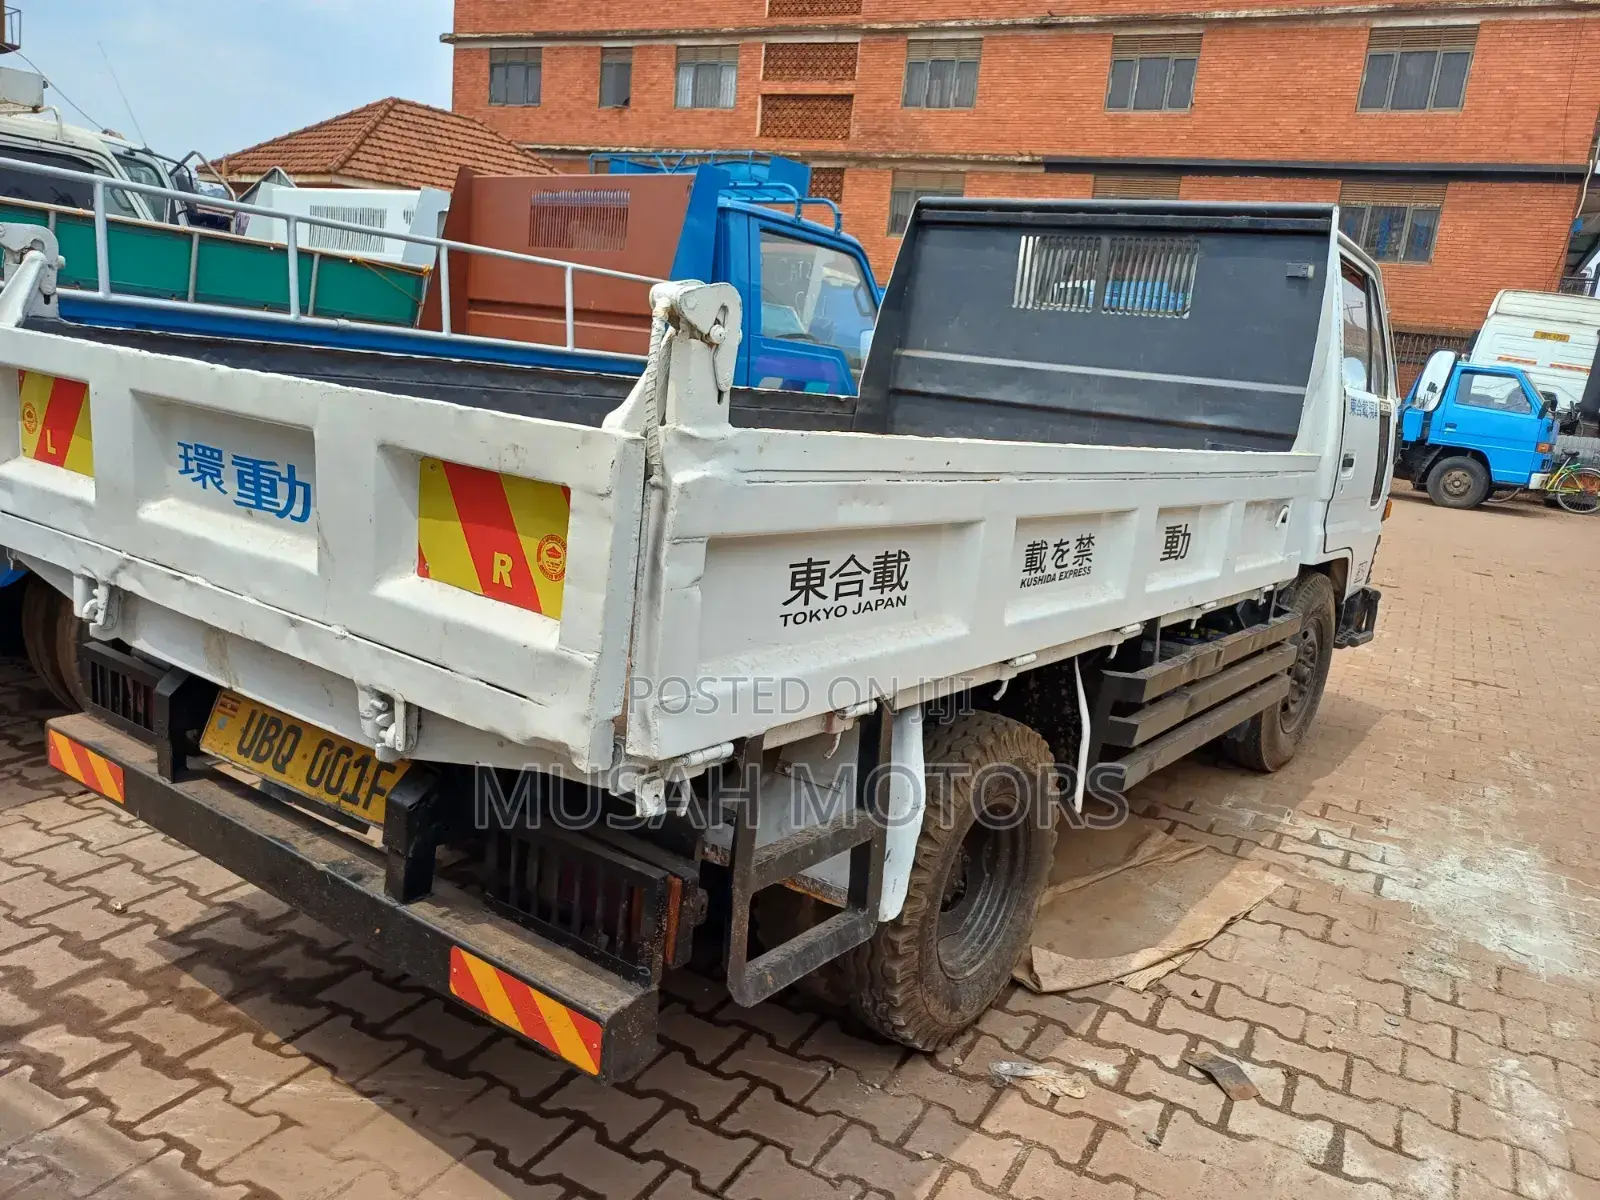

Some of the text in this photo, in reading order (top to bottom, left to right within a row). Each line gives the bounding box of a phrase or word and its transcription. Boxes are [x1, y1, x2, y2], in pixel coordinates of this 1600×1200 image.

[46, 429, 56, 455] L
[177, 441, 312, 523] 環動
[1022, 533, 1095, 576] 載を禁
[1160, 523, 1191, 562] 動
[492, 550, 513, 588] R
[781, 549, 911, 606] 東合載
[1019, 566, 1092, 588] KUSHIDA EXPRESS
[779, 594, 907, 627] TOKYO JAPAN
[236, 708, 397, 811] UBQ 001F
